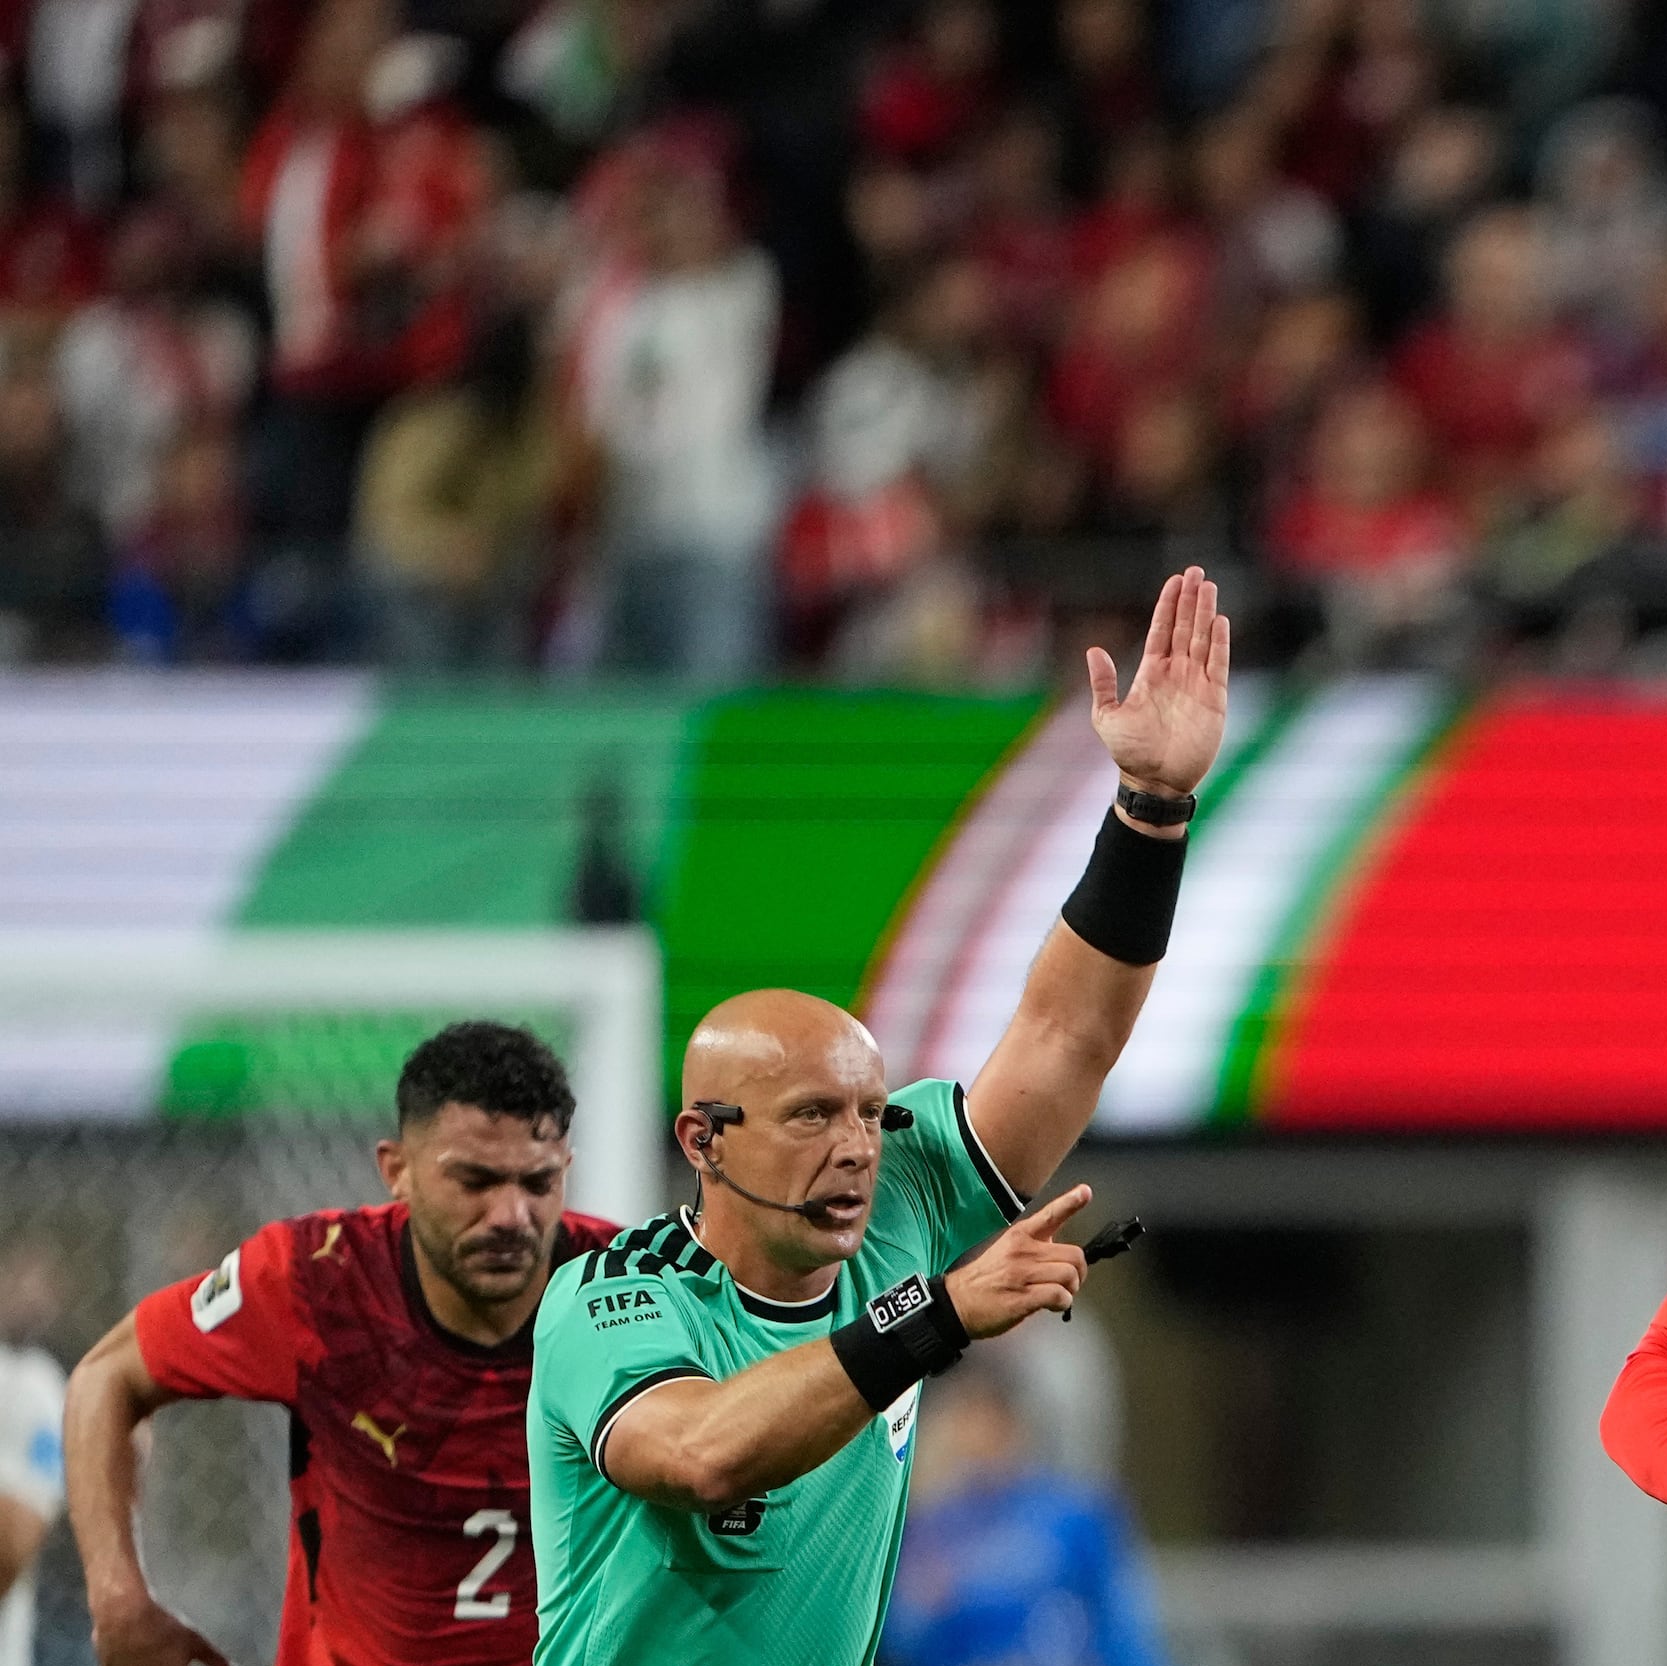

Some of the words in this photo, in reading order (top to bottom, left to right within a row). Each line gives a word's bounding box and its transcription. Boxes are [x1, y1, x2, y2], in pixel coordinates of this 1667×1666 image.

[587, 1290, 656, 1319] FIFA
[594, 1317, 630, 1332] TEAM
[634, 1311, 663, 1322] ONE
[722, 1520, 746, 1528] FIFA
[453, 1508, 518, 1620] 2
